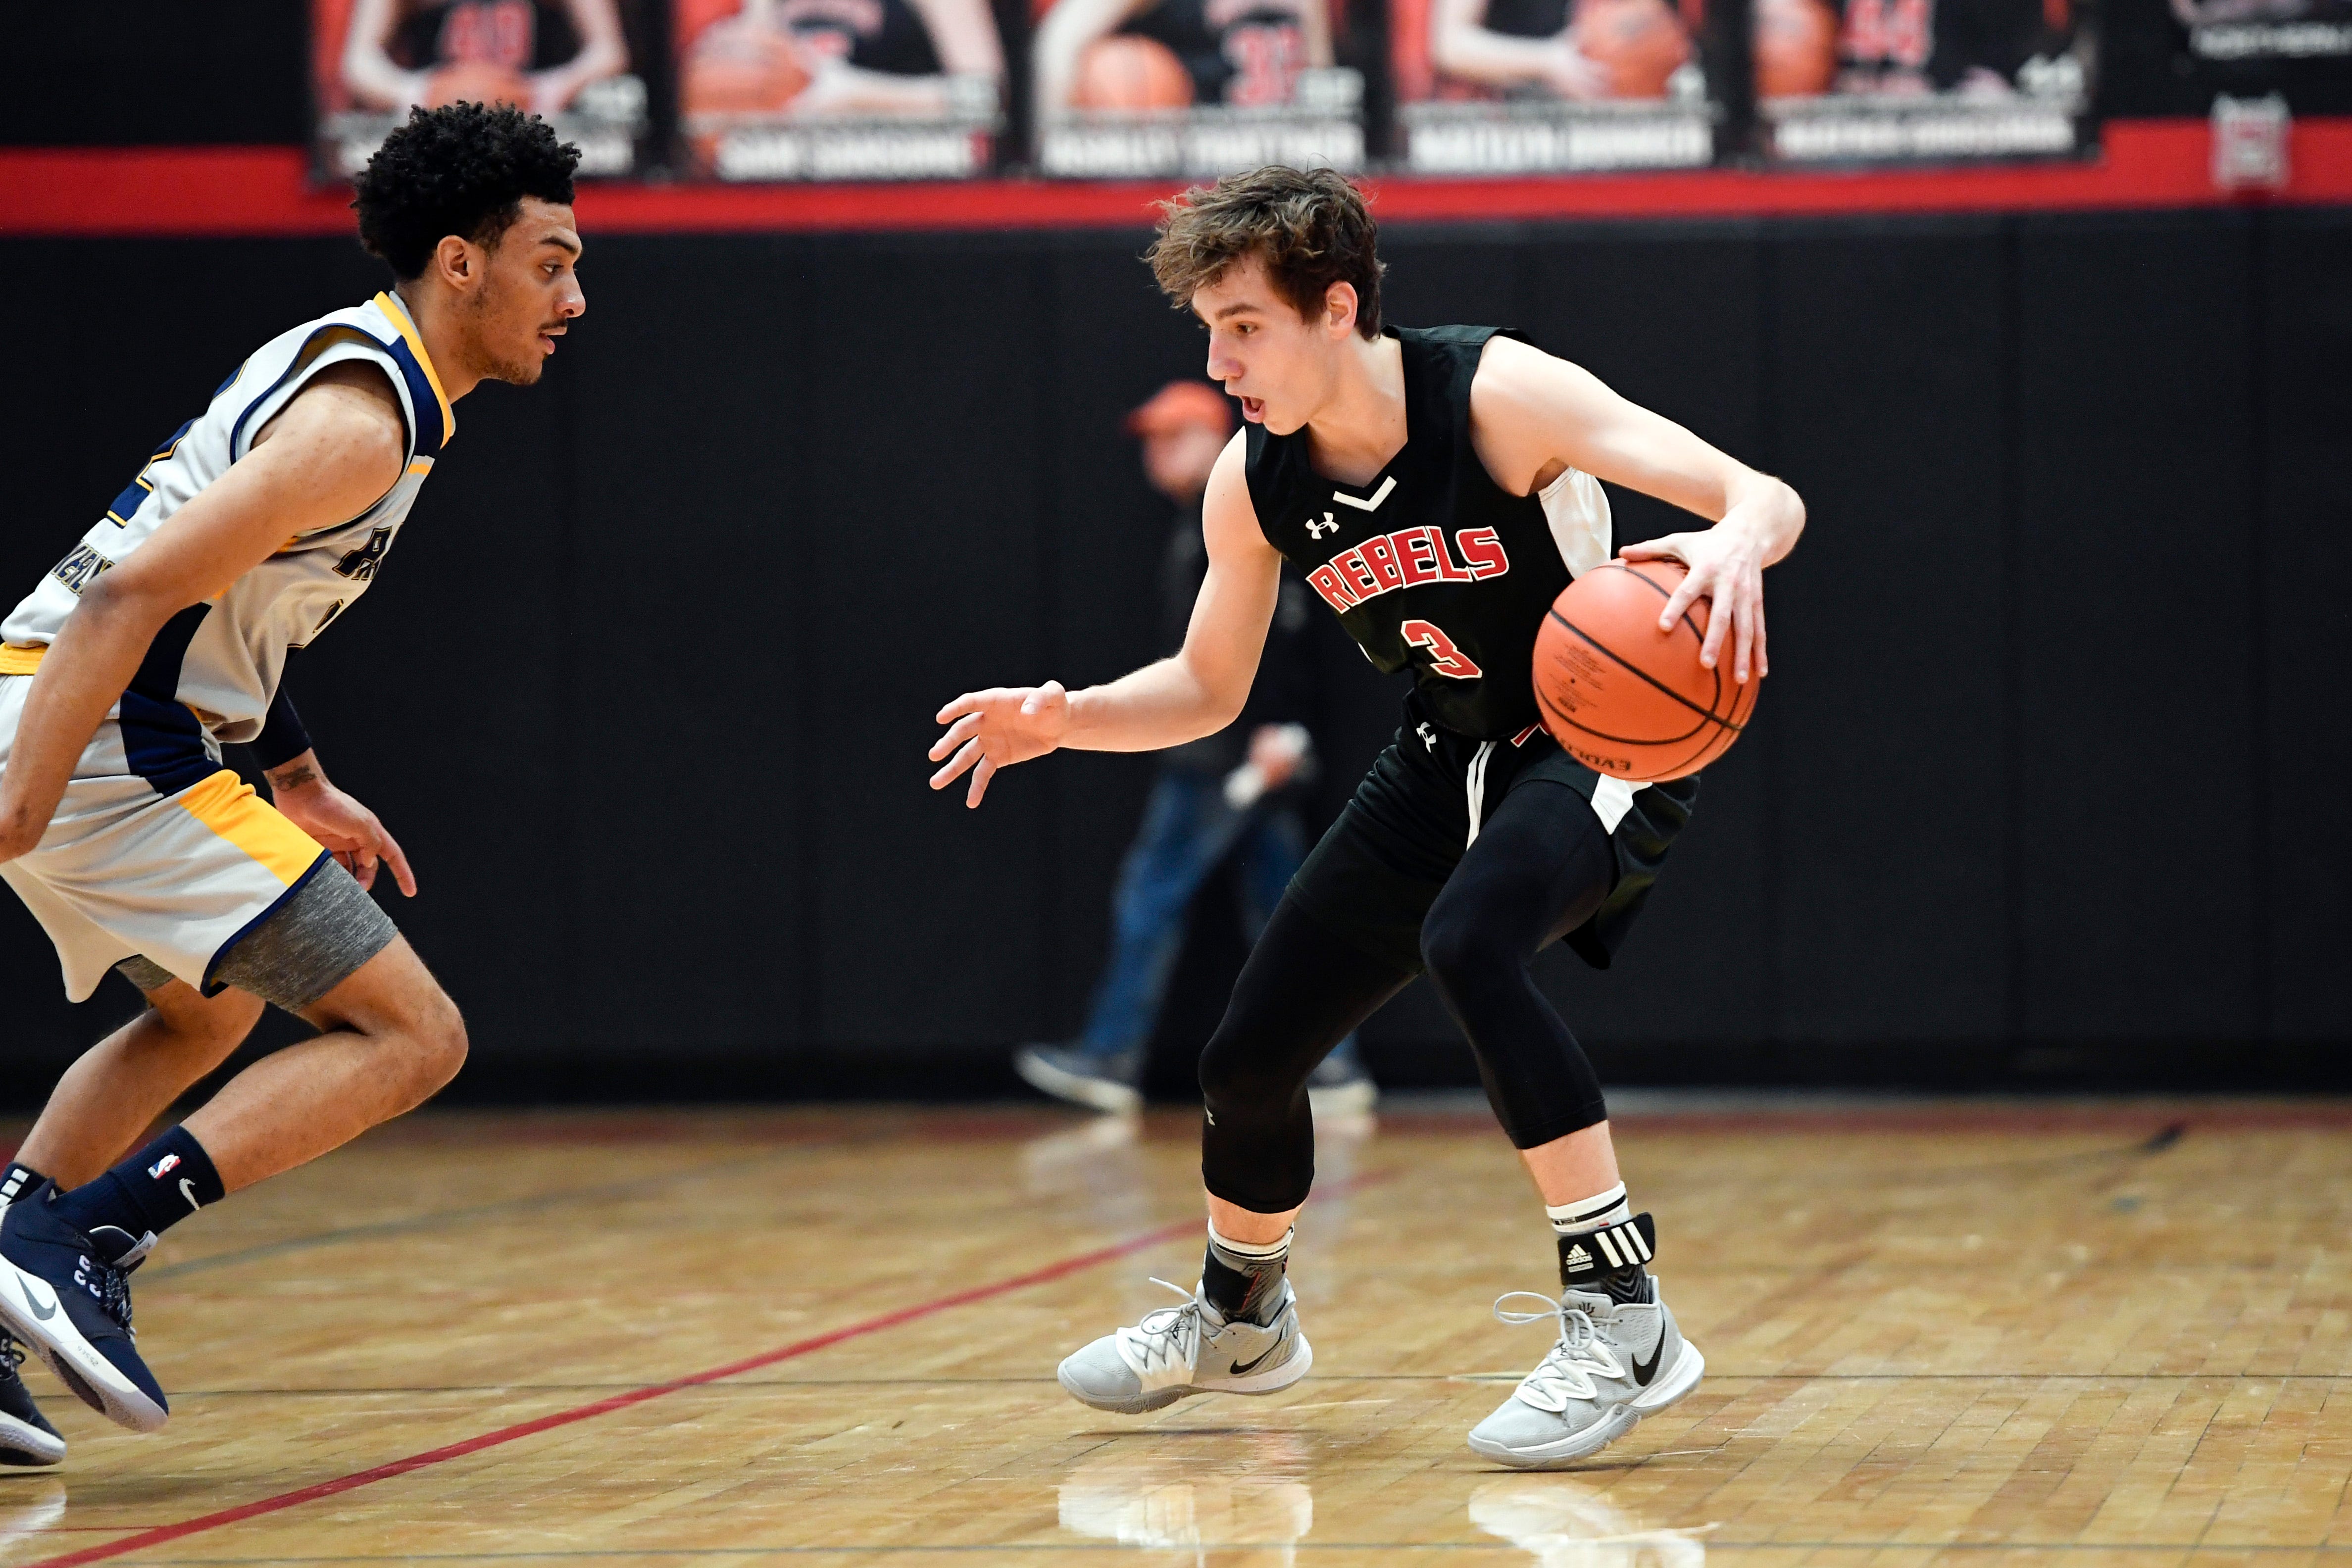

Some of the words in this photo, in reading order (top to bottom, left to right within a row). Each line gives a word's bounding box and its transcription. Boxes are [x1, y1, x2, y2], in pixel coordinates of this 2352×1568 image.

[1305, 526, 1509, 614] REBELS
[1401, 620, 1483, 679] 3
[1566, 1255, 1593, 1266] adidas
